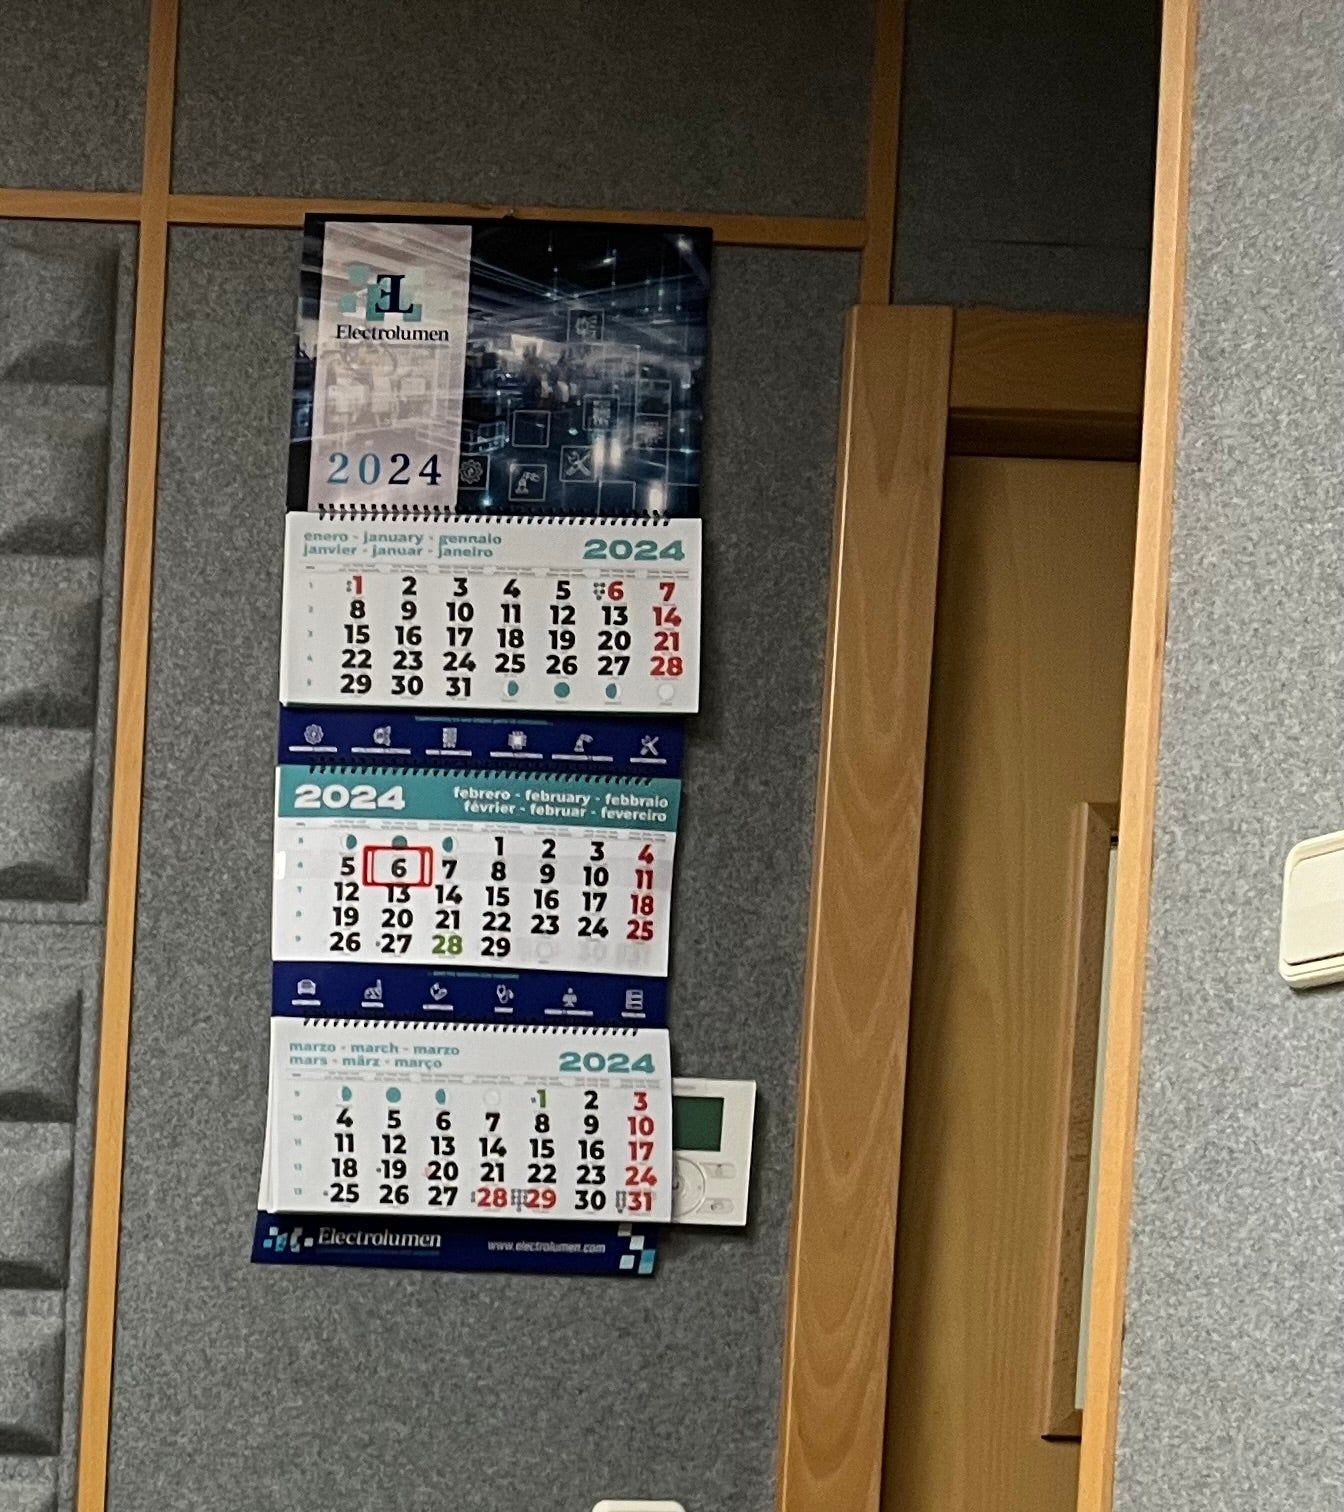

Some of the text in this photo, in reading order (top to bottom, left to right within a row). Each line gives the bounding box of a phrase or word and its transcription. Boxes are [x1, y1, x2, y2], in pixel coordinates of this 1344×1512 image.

[336, 324, 450, 342] Electrolumen
[327, 452, 442, 486] 2024
[304, 531, 349, 543] enero
[363, 530, 424, 546] january
[371, 543, 423, 559] januar
[582, 538, 686, 562] 2024
[352, 575, 676, 602] 1 2 3 4 5 6 7
[349, 599, 682, 627] 8 9 10 11 12 13 14
[343, 623, 680, 652] 15 16 17 18 19 20 21
[341, 648, 684, 677] 22 23 24 25 26 27 28
[340, 673, 472, 698] 29 30 31
[293, 783, 407, 812] 2024
[453, 785, 669, 809] febrero february febbraio
[529, 803, 587, 818] februar
[600, 806, 668, 823] fevereiro
[494, 836, 655, 865] 1 2 3 4
[340, 856, 654, 891] 5 6 7 8 9 10 11
[334, 881, 654, 917] 12 13 14 15 16 17 18
[332, 906, 654, 942] 19 20 21 22 23 24 25
[329, 931, 511, 958] 26 27 28 29
[288, 1040, 461, 1057] marzo march marzo
[288, 1054, 328, 1066] mars
[557, 1051, 657, 1074] 2024
[536, 1088, 648, 1112] 1 2 3
[336, 1107, 655, 1137] 4 5 6 7 8 9 10
[334, 1132, 654, 1161] 11 12 13 14 15 16 17
[331, 1157, 658, 1187] 18 19 20 21 22 23 24
[330, 1182, 653, 1212] 25 26 27 28 29 30 31
[317, 1226, 443, 1250] Electrolumen
[487, 1239, 607, 1255] www.electrolumen.com
